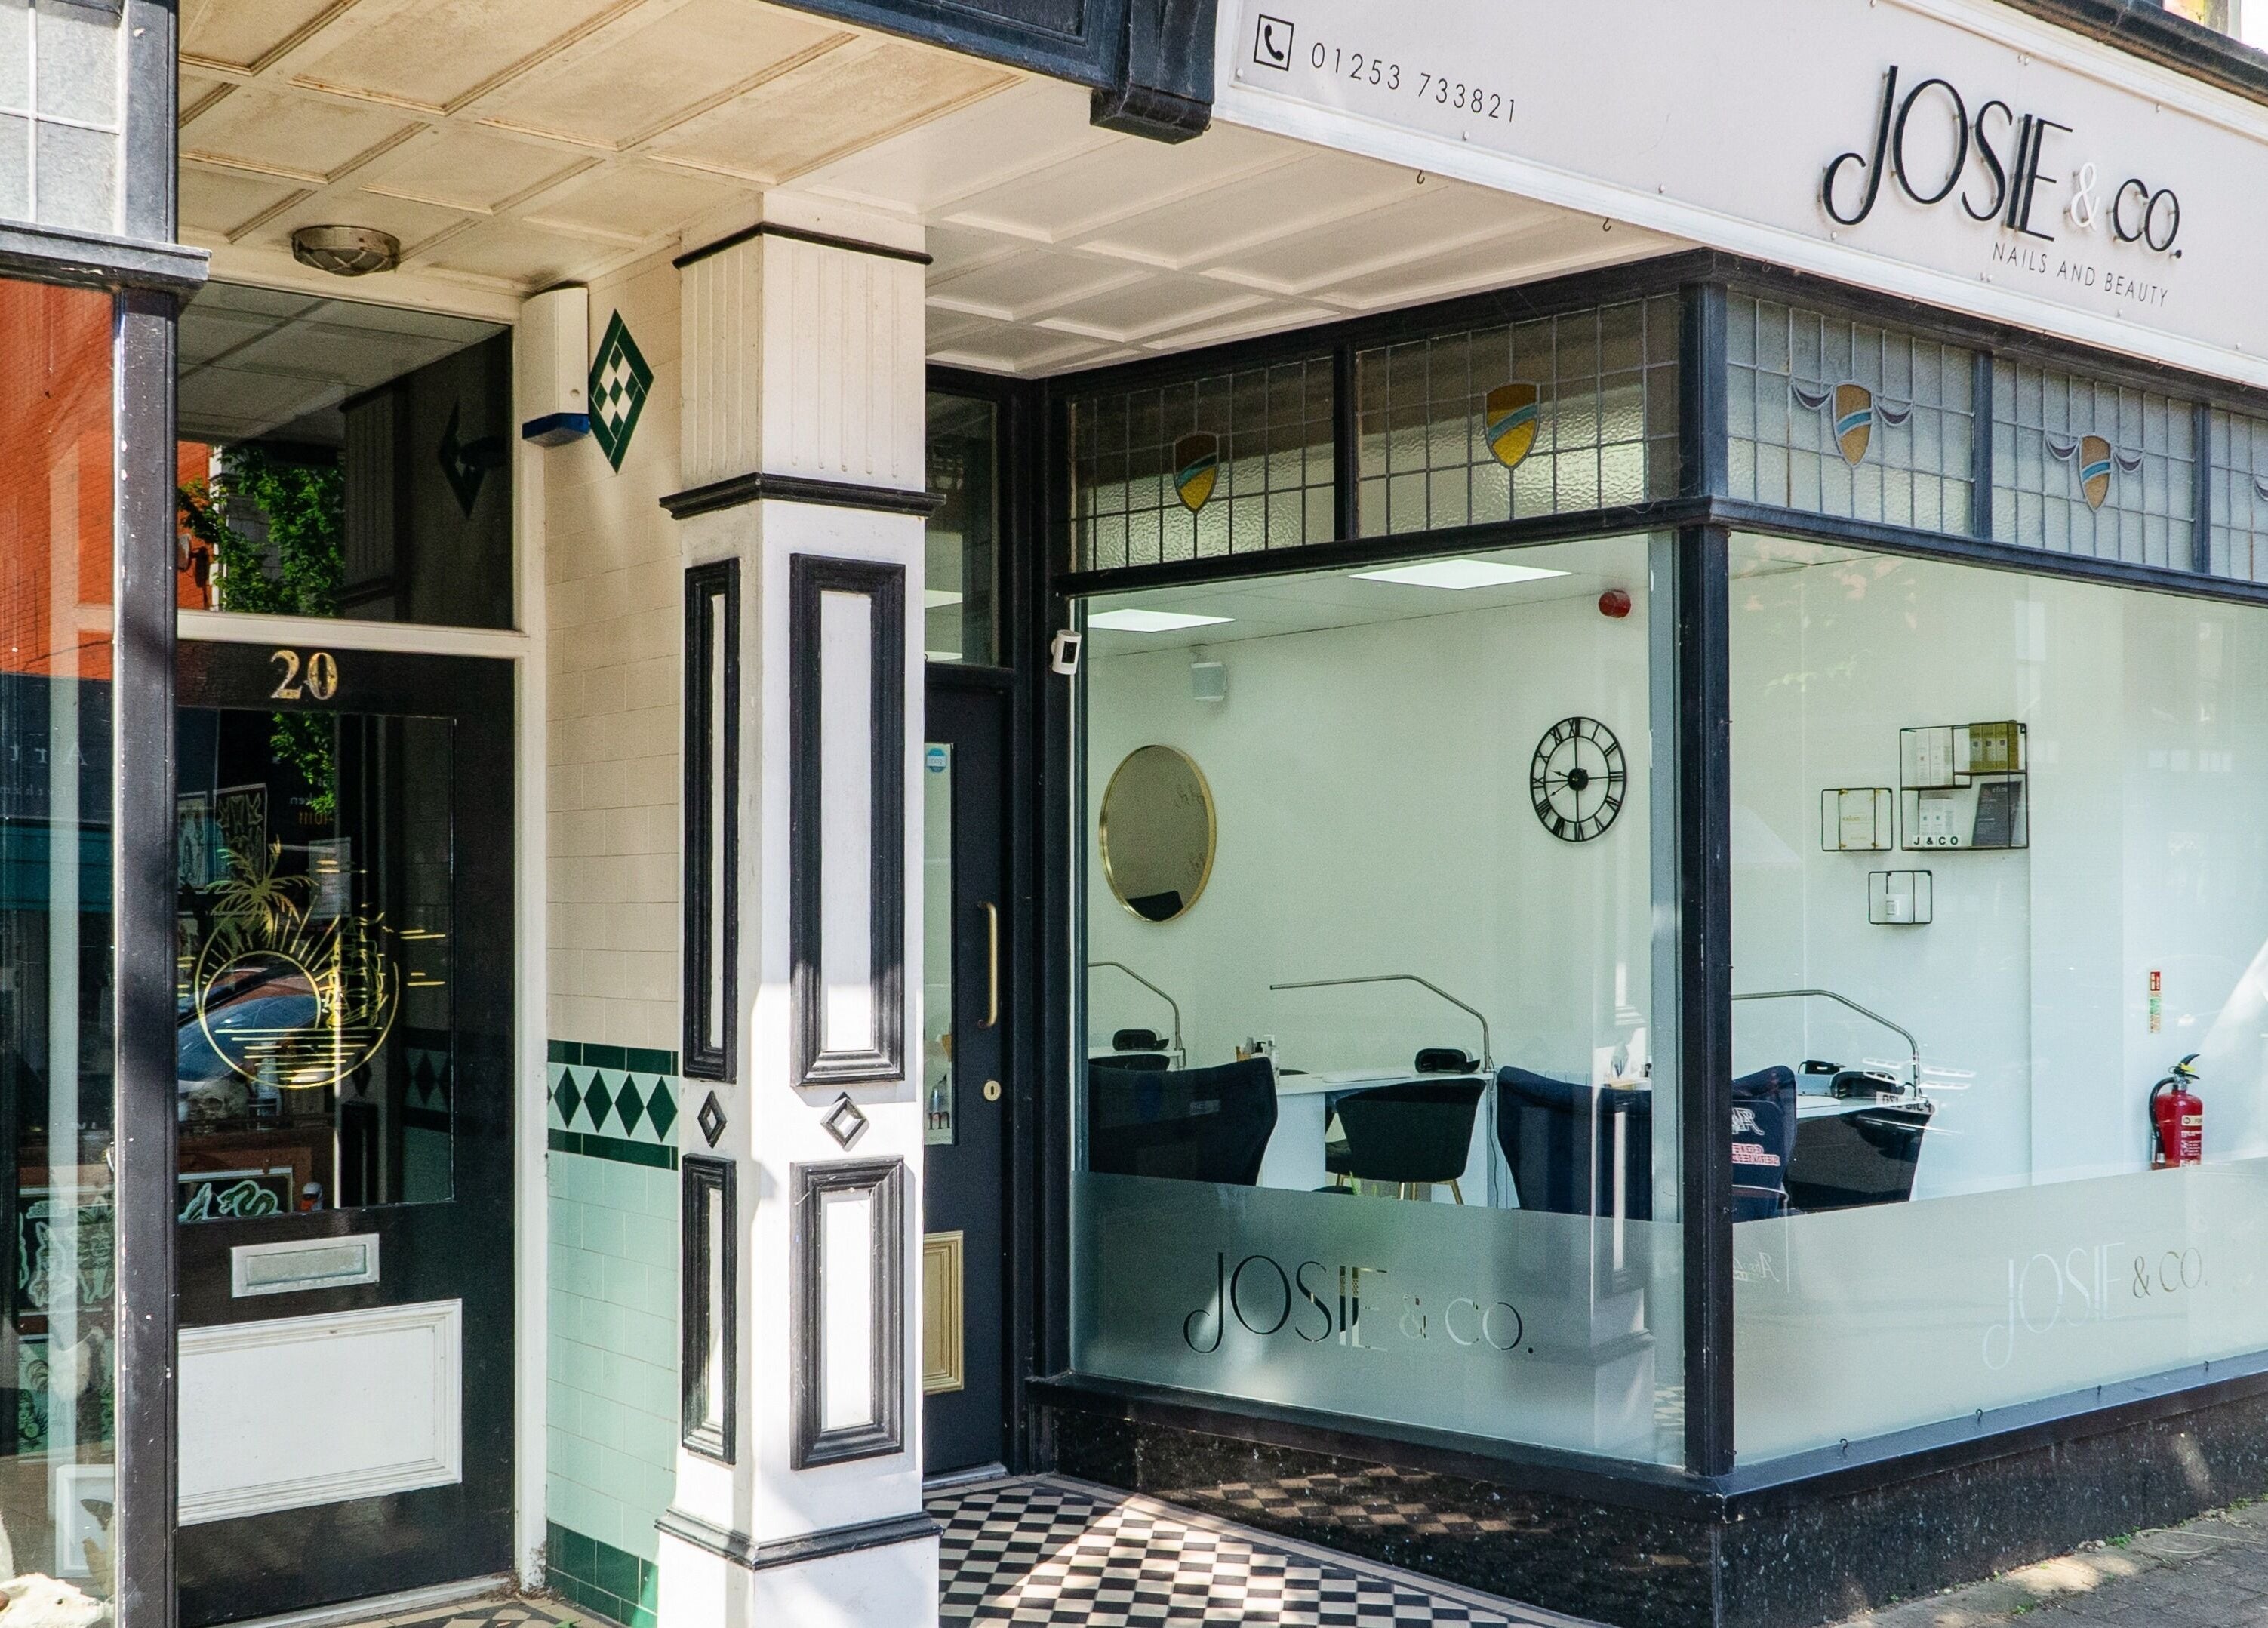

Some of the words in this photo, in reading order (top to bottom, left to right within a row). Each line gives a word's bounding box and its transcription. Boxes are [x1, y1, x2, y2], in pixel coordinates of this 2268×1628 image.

[1311, 42, 1401, 90] 01253
[1417, 72, 1516, 123] 733821
[1822, 65, 2073, 242] JOSIE
[2070, 162, 2100, 230] &
[2112, 178, 2183, 259] CO.
[1992, 242, 2047, 274] NAILS
[2057, 260, 2096, 288] AND
[2104, 272, 2168, 307] BEAUTY
[270, 649, 339, 700] 20
[1183, 1251, 1388, 1354] JOSIE
[1399, 1293, 1429, 1340] &
[1444, 1297, 1534, 1354] CO.
[1982, 1242, 2125, 1370] JOSIE
[2133, 1255, 2151, 1299] &
